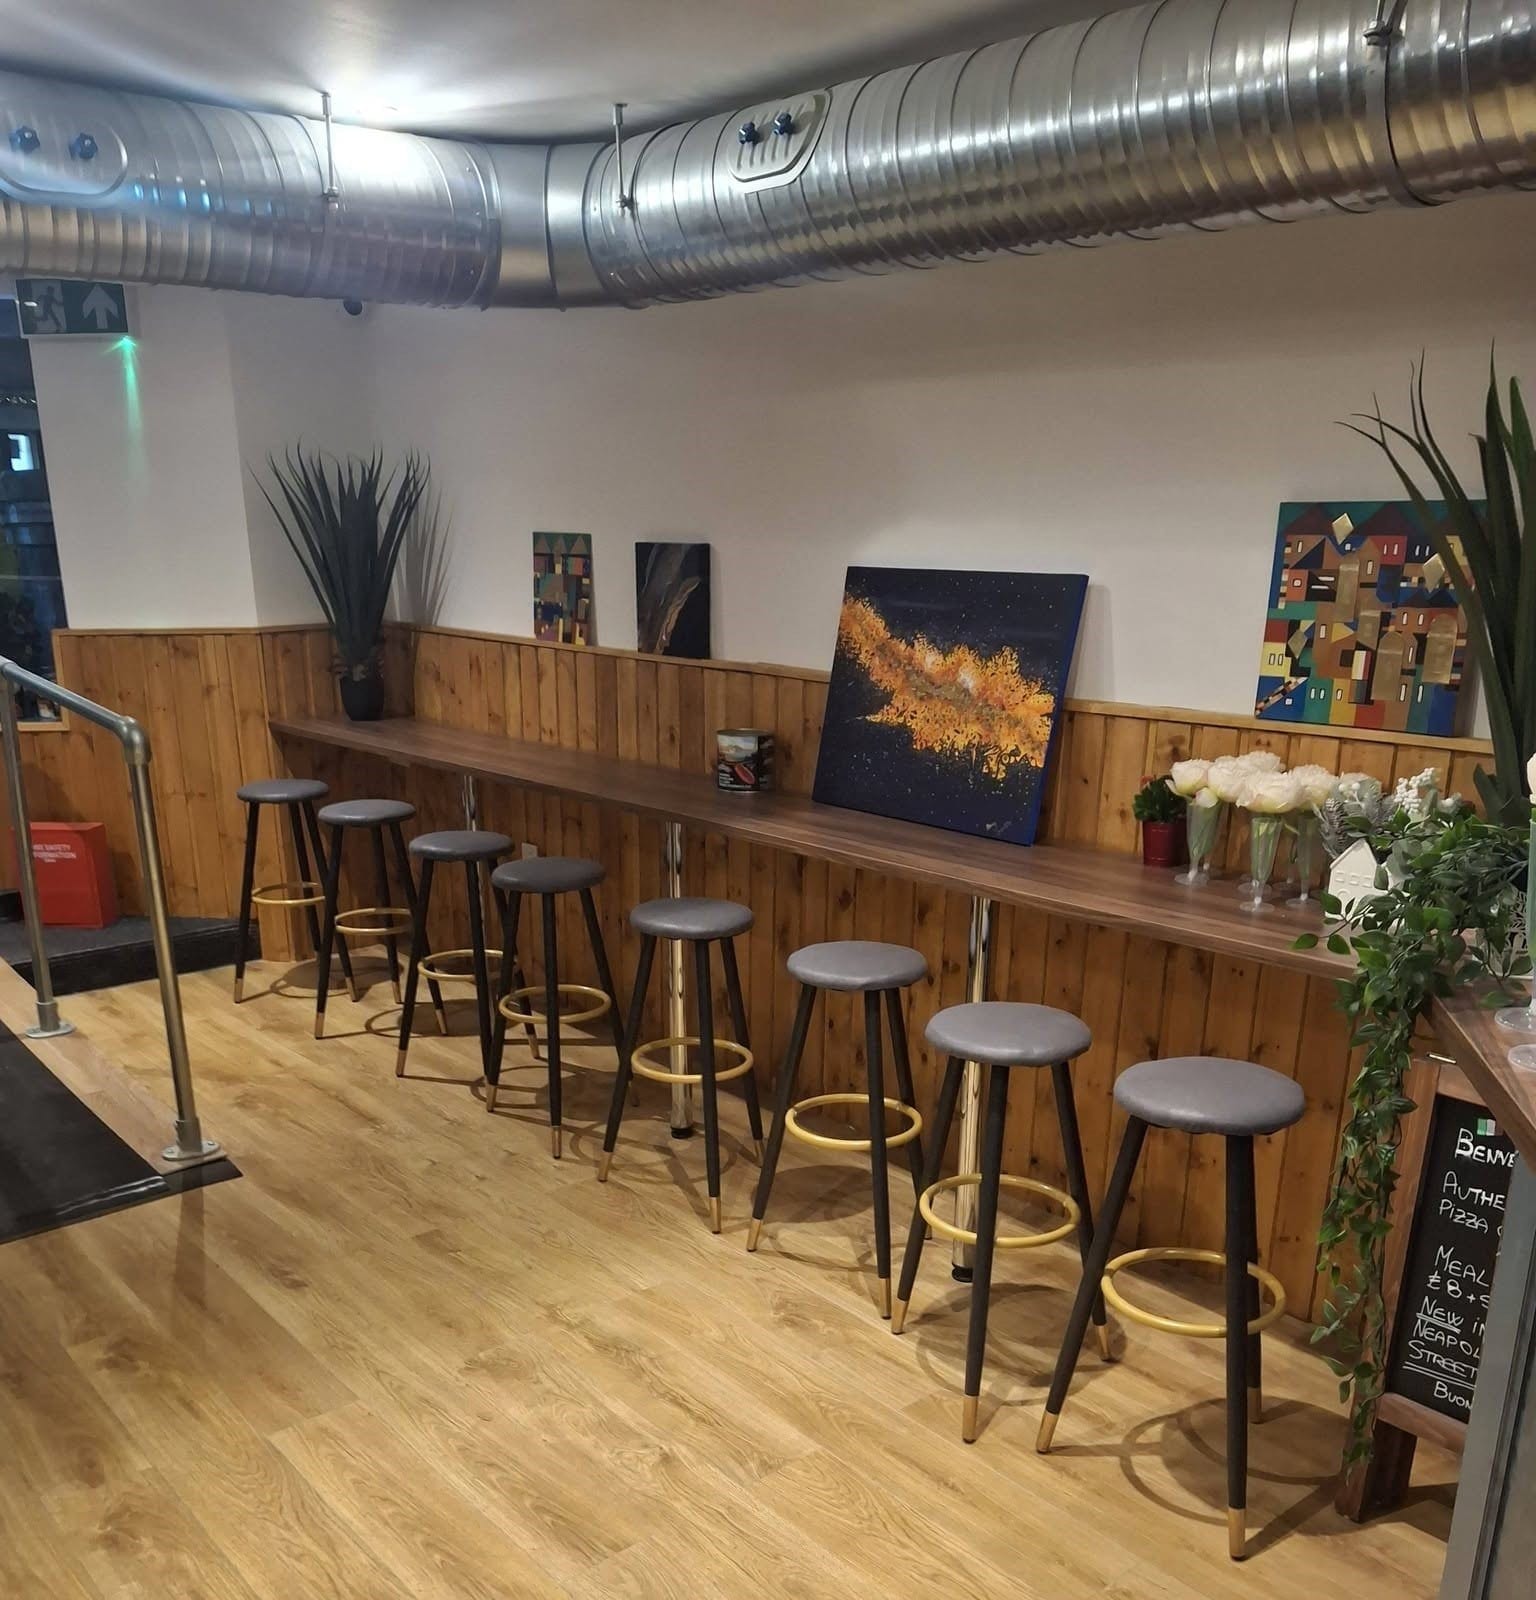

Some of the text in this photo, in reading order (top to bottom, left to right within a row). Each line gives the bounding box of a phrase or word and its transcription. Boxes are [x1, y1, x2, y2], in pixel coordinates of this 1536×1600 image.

[1443, 1170, 1506, 1212] AUTHE
[1434, 1244, 1490, 1288] MEAL
[1419, 1295, 1464, 1327] NEW
[1407, 1339, 1480, 1379] STREET
